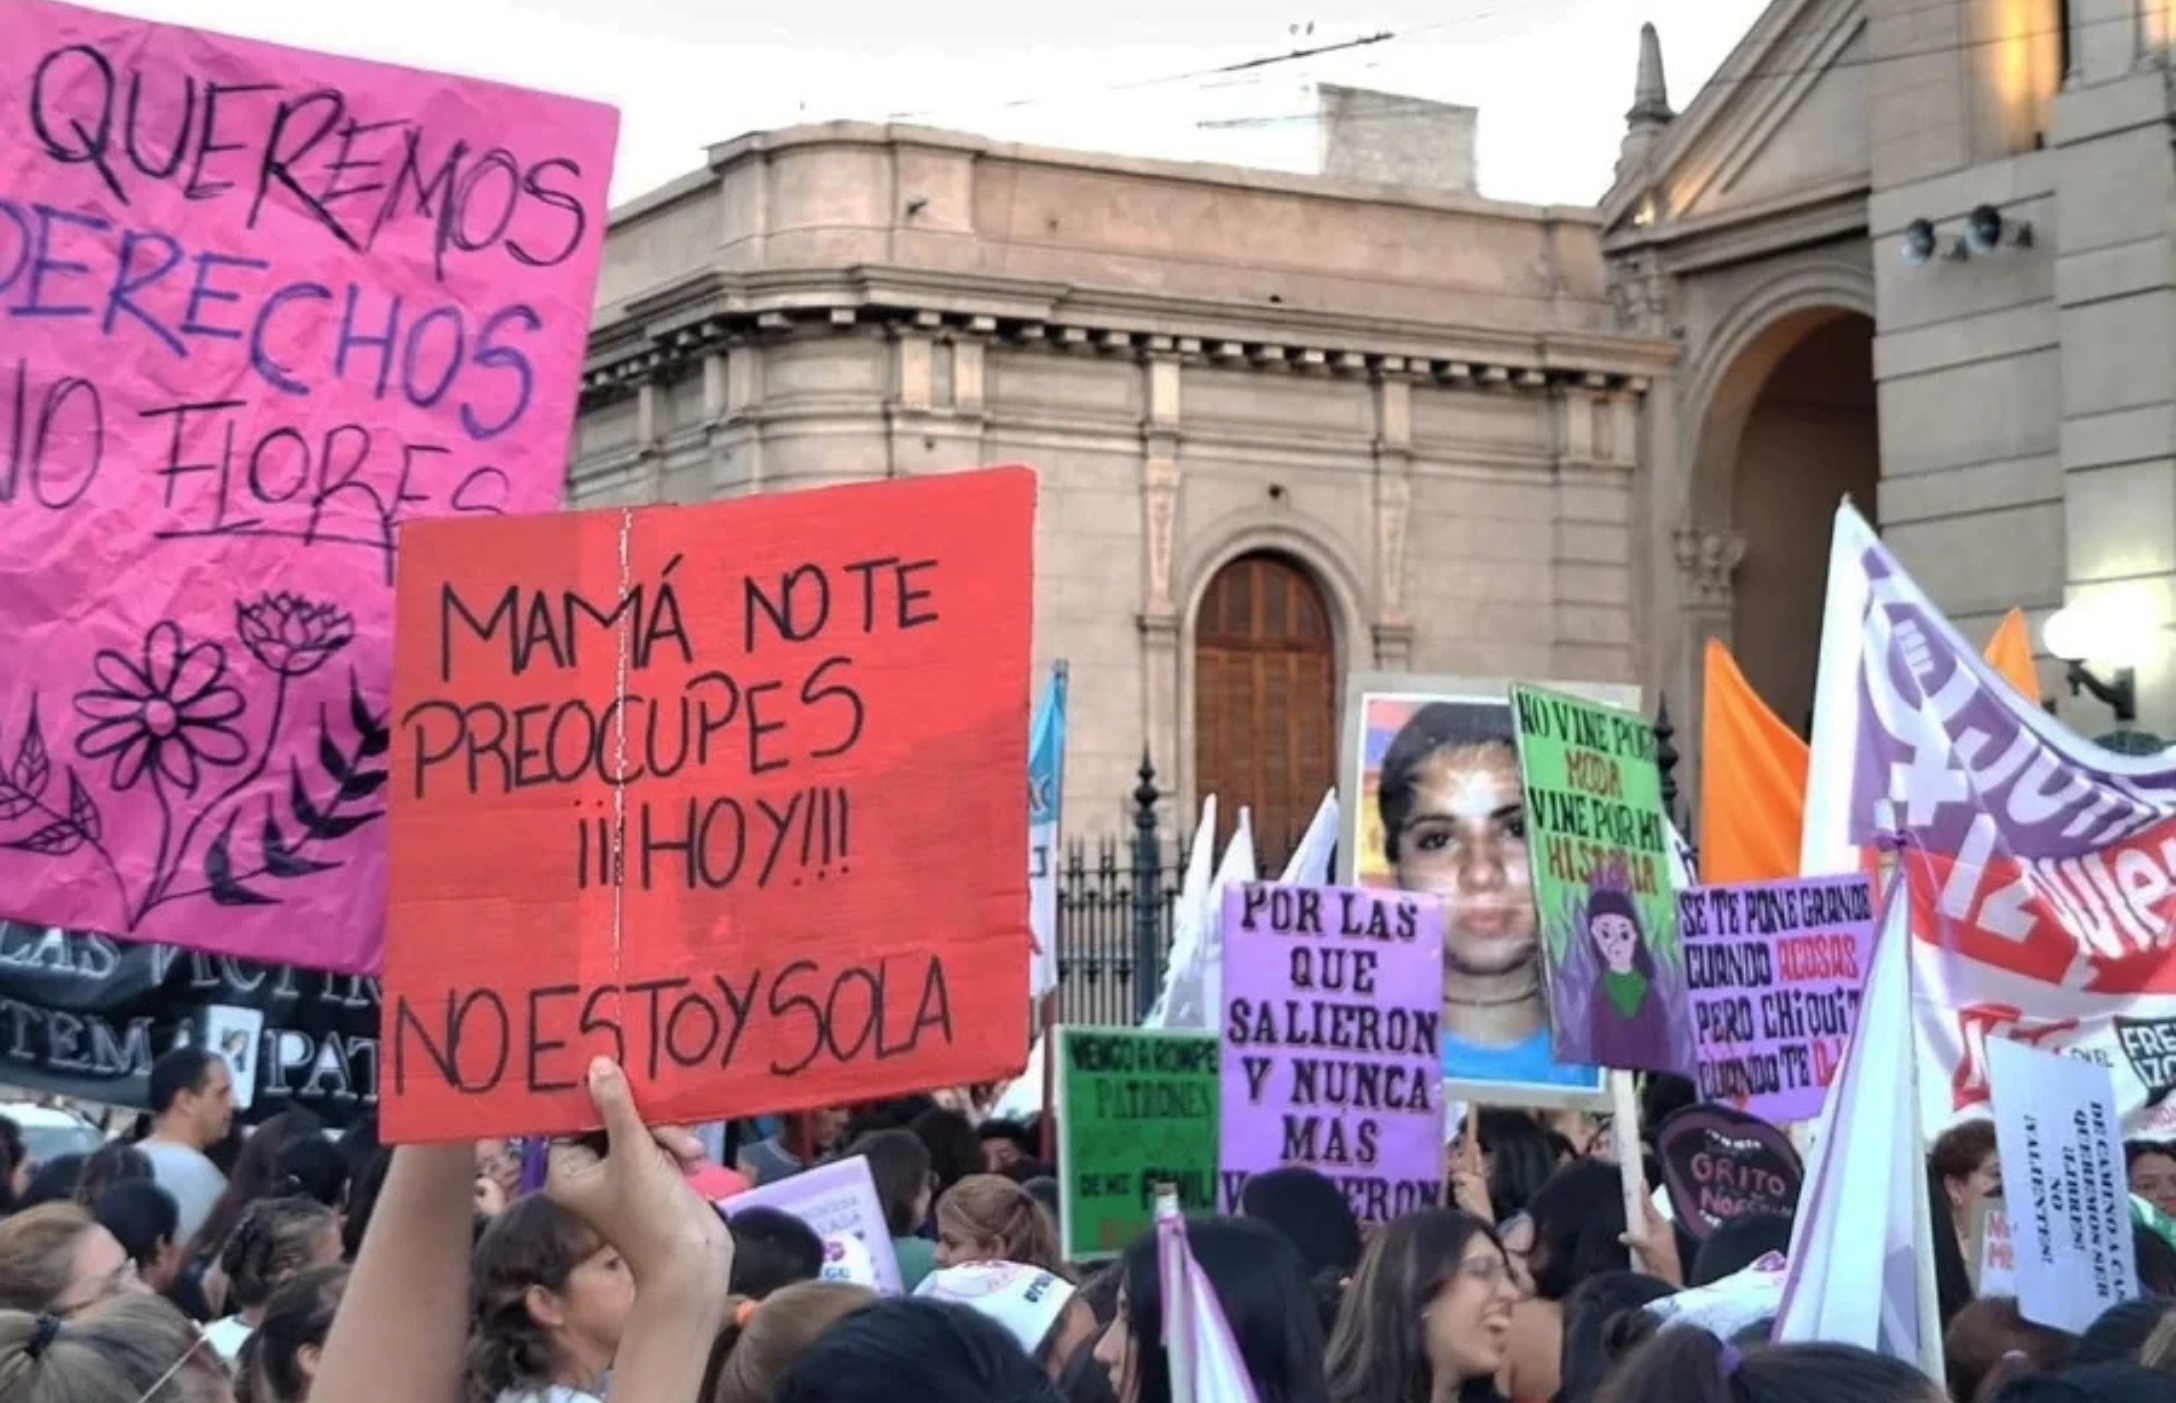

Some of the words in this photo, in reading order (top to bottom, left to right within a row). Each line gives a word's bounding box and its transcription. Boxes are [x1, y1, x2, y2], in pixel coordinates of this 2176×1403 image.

[30, 44, 586, 283] QUEREMOS
[442, 554, 692, 682] MAMÁ
[744, 564, 829, 653] NO
[843, 557, 938, 632] TE
[401, 657, 864, 799] PREOCUPES
[1517, 692, 1549, 737] NO
[1552, 700, 1608, 752] VINE
[1565, 748, 1623, 799] MODA
[1528, 785, 1590, 837] VINE
[1591, 798, 1636, 847] POR
[1637, 808, 1666, 853] MI
[1242, 881, 1322, 933] POR
[1340, 892, 1418, 940] LAS
[1680, 890, 1708, 937] SE
[1709, 888, 1740, 935] TE
[1743, 887, 1799, 934] PONE
[1800, 881, 1873, 928] GRANDE
[1290, 946, 1377, 994] QUE
[1684, 942, 1773, 990] CUANDO
[1776, 934, 1860, 982] ACOSAS
[395, 988, 510, 1097] NO
[527, 970, 760, 1092] ESTOY
[768, 956, 952, 1076] SOLA
[1228, 997, 1439, 1055] SALIERON
[1695, 996, 1754, 1044] PERO
[1291, 1058, 1431, 1111] NUNCA
[1700, 1054, 1780, 1101] CUANDO
[1780, 1044, 1811, 1089] TE
[1281, 1106, 1378, 1164] MÁS
[1690, 1151, 1786, 1197] GRITO
[2050, 1176, 2063, 1212] NO
[2097, 1138, 2119, 1236] CAMINO
[2073, 1108, 2102, 1247] QUEREMOS
[2094, 1250, 2110, 1299] SER
